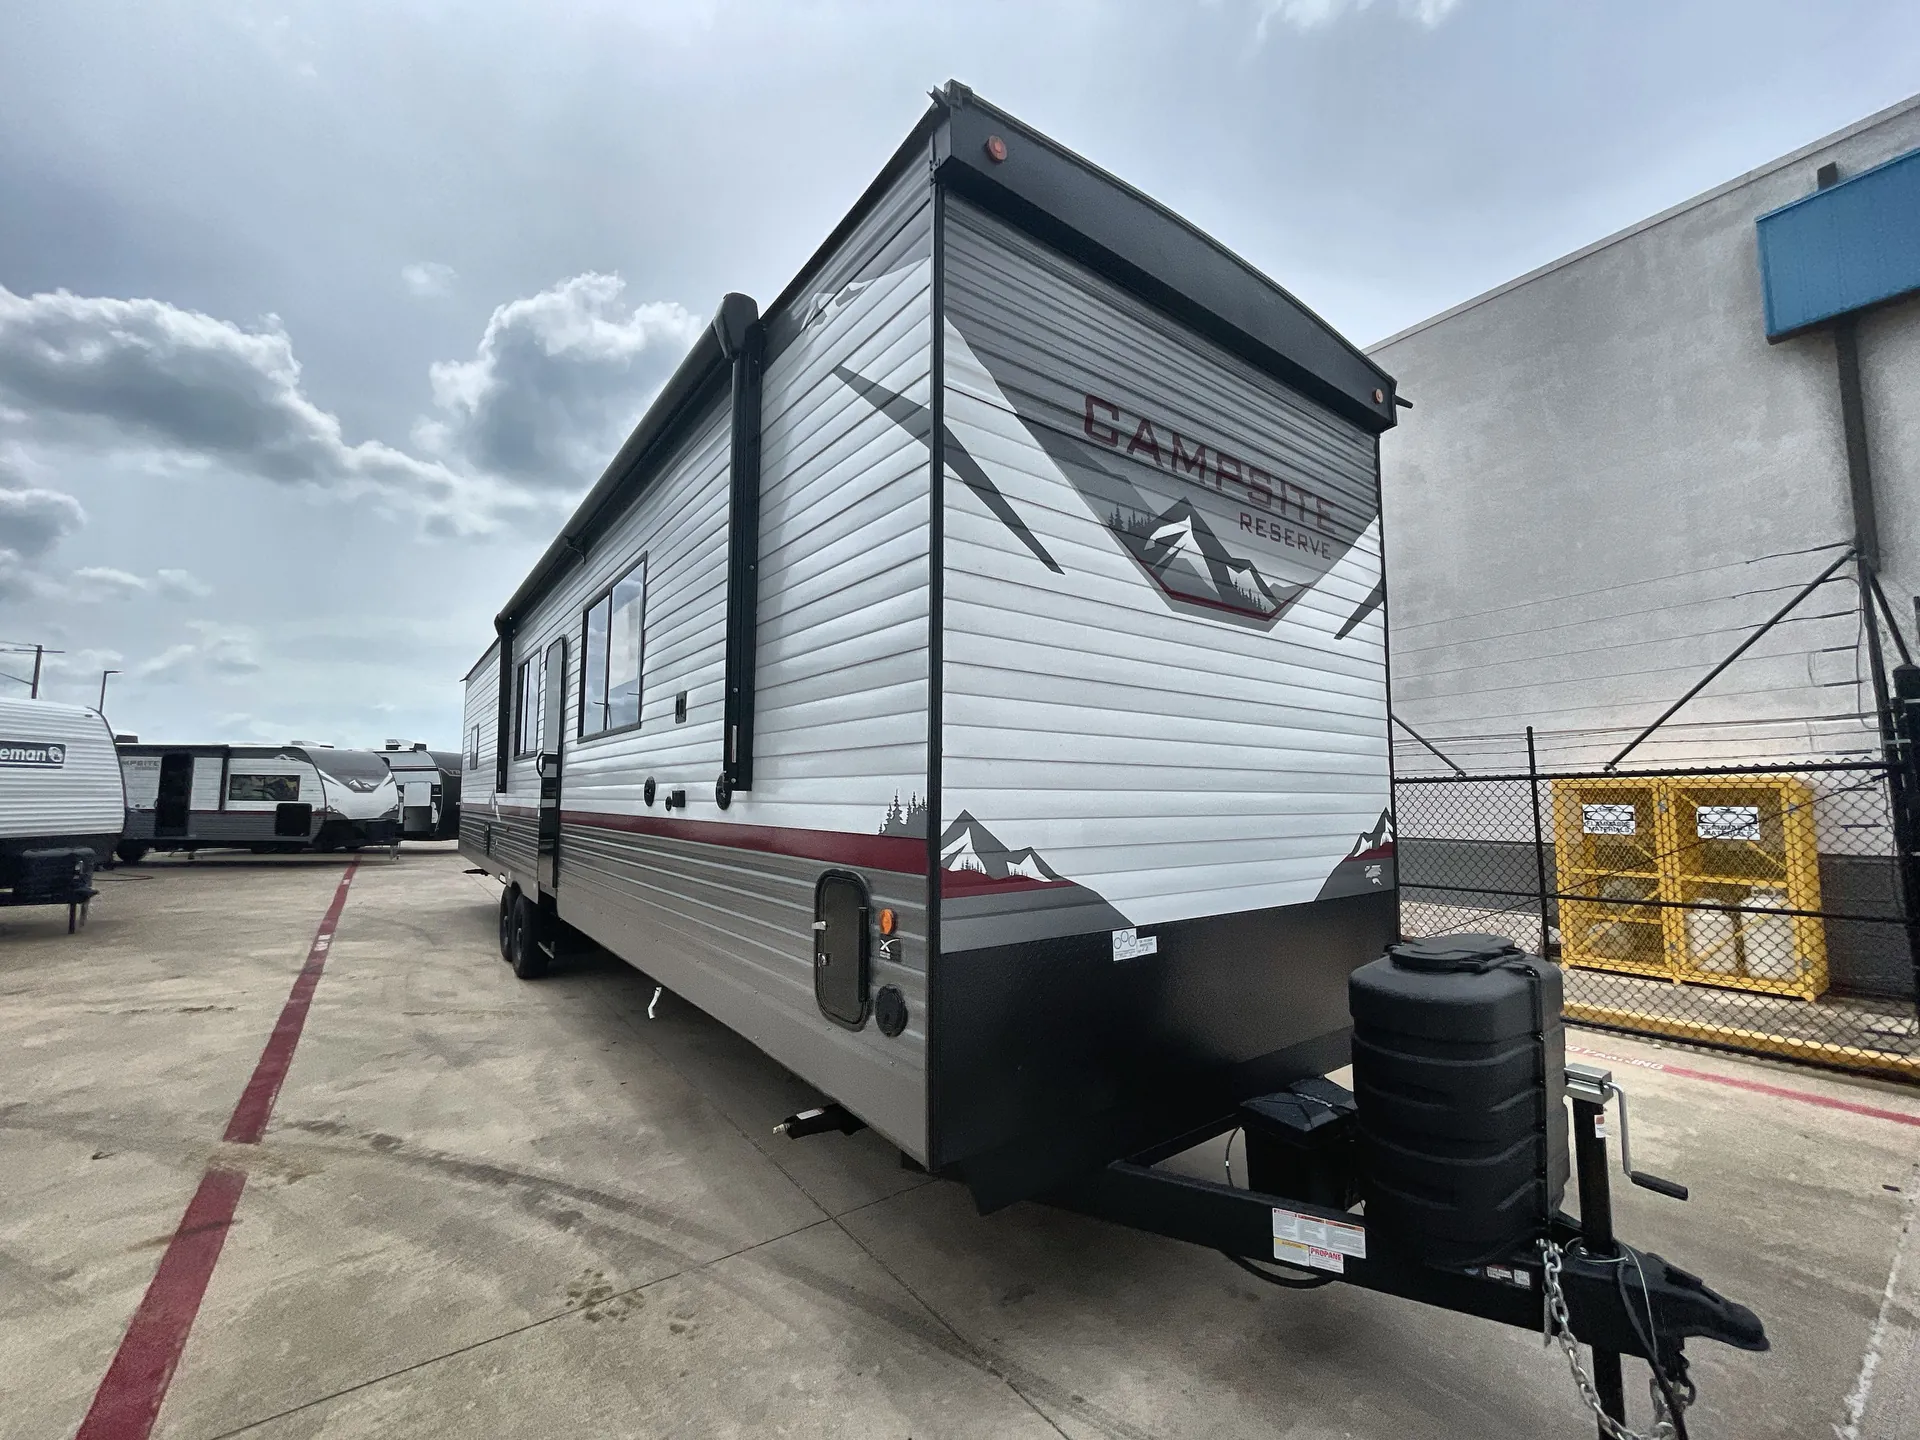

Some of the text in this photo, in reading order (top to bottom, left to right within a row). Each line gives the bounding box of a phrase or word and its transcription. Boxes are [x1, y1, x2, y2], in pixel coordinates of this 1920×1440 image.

[1084, 394, 1336, 533] CAMPSITE
[1239, 512, 1332, 560] RESERVE
[1311, 1248, 1341, 1260] PROPANE
